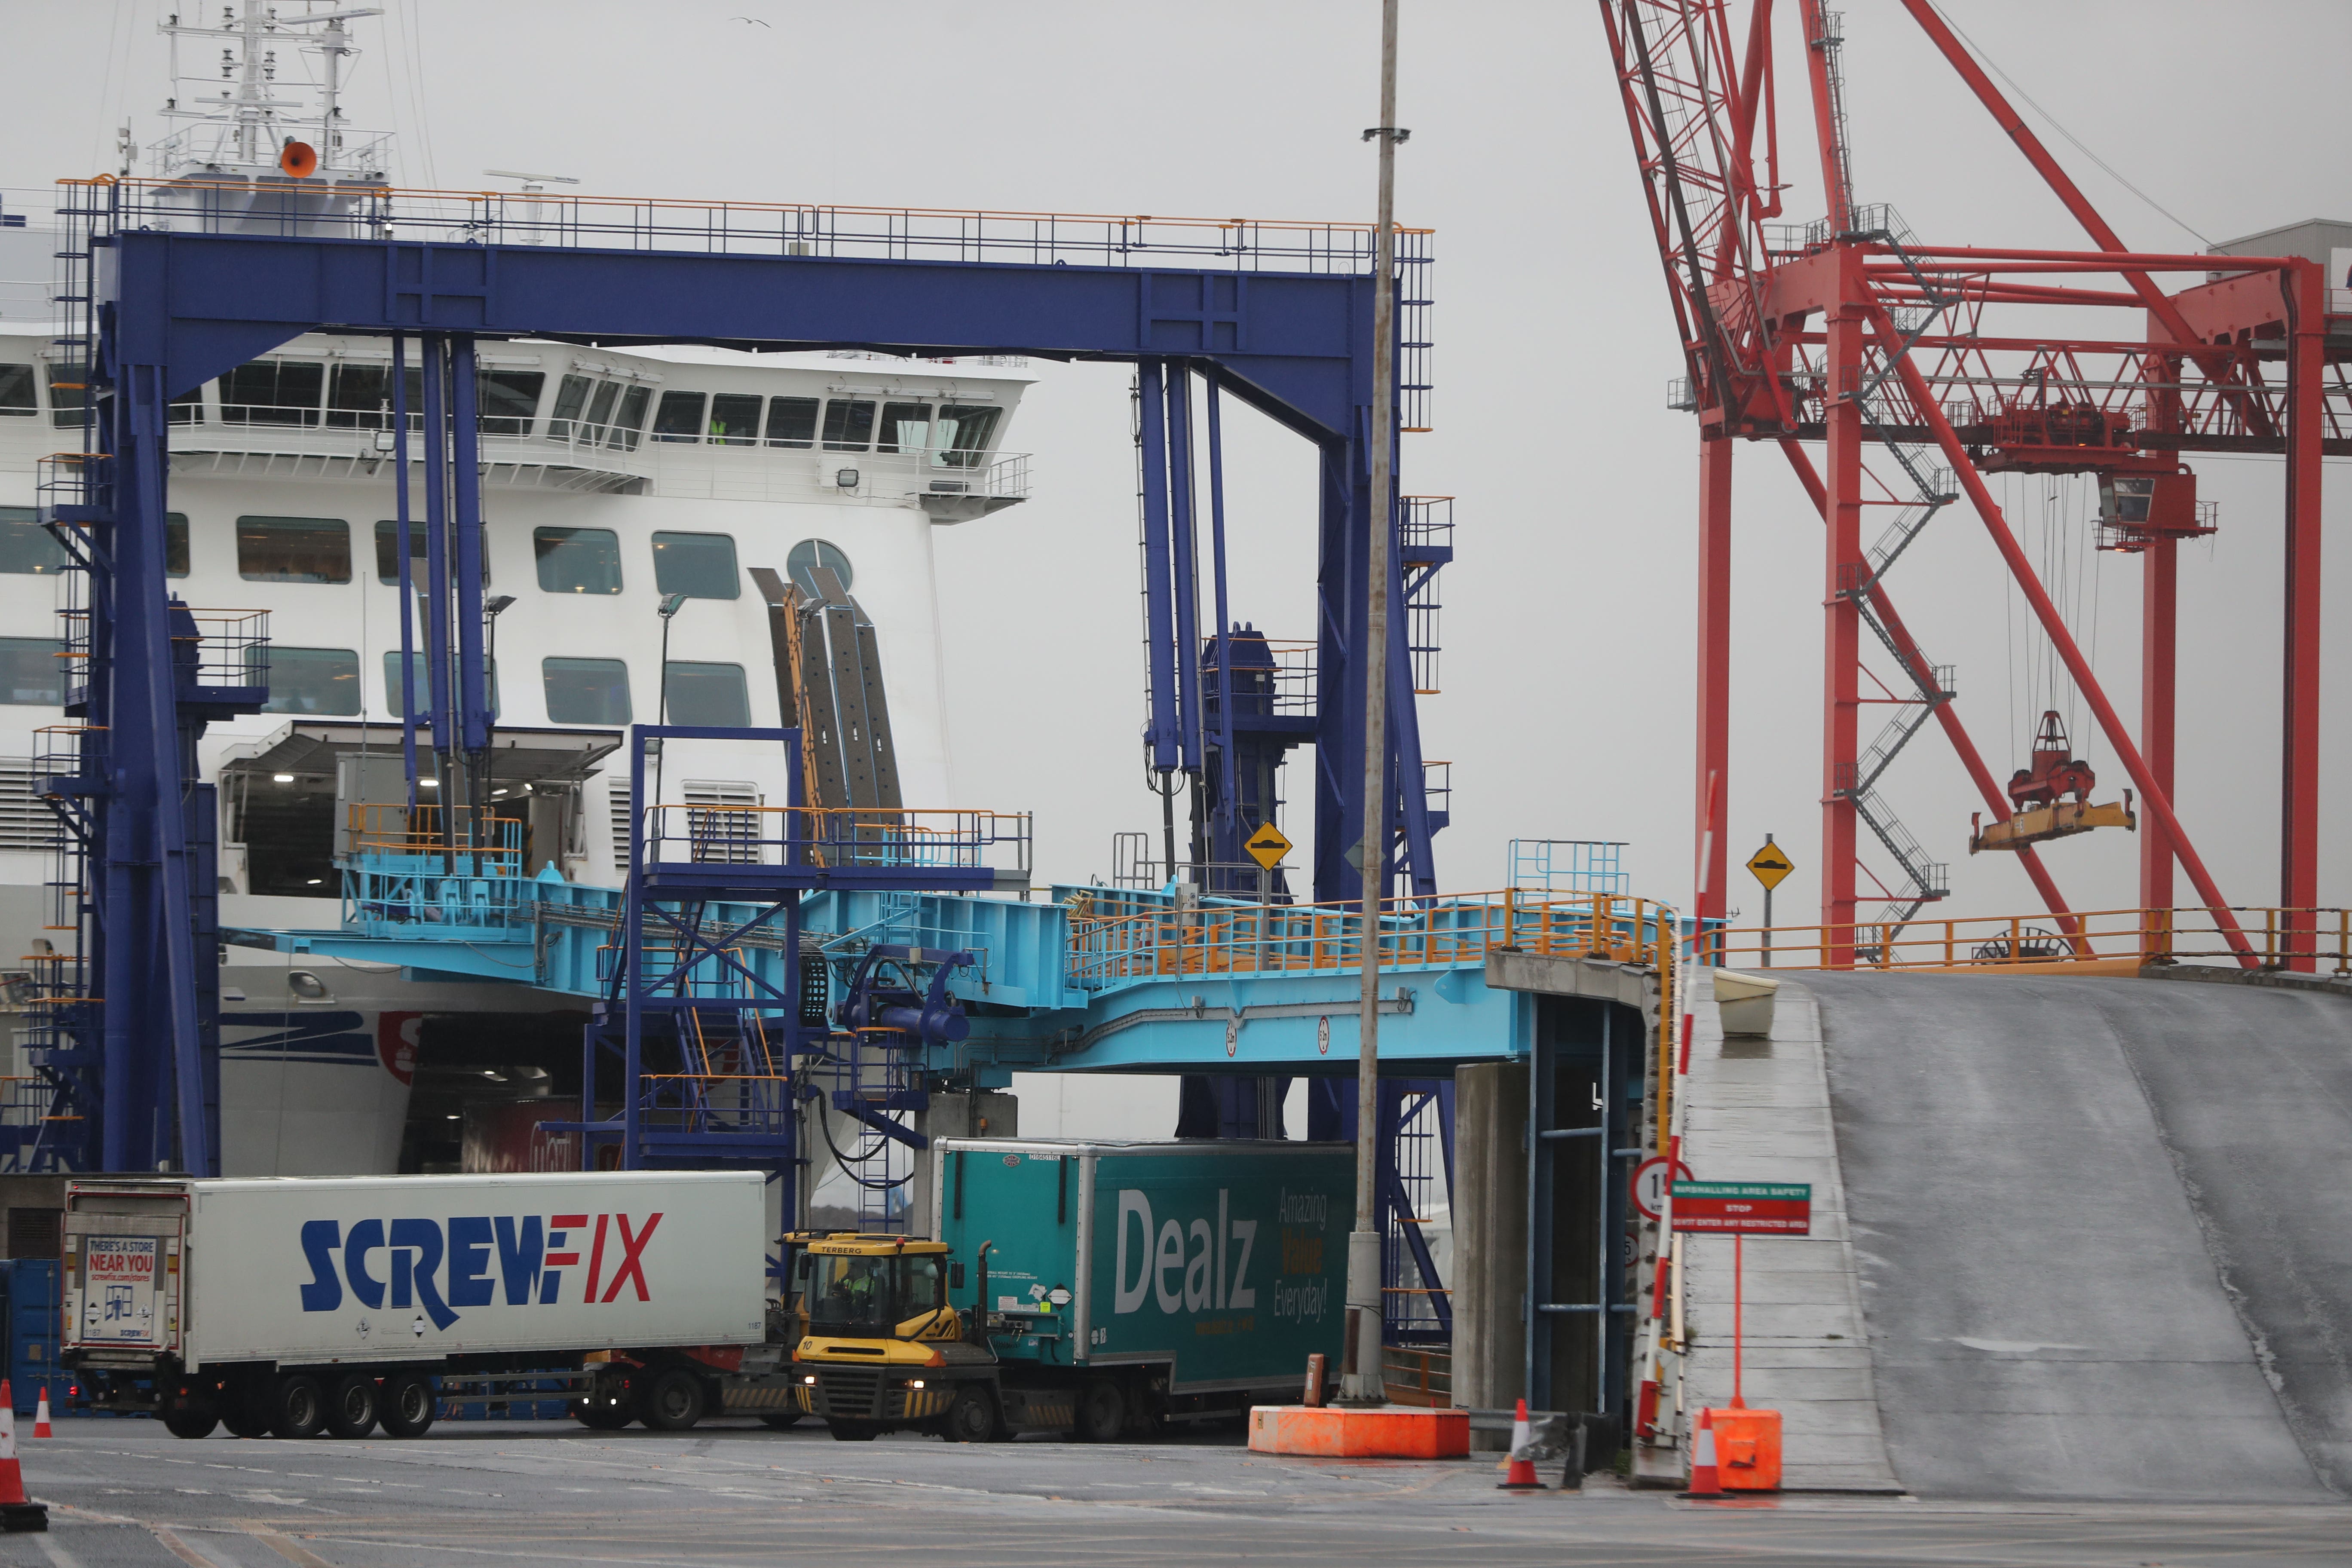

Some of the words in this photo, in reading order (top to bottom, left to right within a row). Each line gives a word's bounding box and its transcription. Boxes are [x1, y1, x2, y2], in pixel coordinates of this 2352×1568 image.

[1674, 1185, 1740, 1194] MARSHALLING
[1741, 1187, 1769, 1195] AREA
[1770, 1188, 1807, 1196] SAFETY
[1279, 1186, 1327, 1231] Amazing
[1725, 1204, 1752, 1213] STOP
[1740, 1219, 1787, 1228] RESTRICTED
[1789, 1220, 1807, 1228] AREA
[90, 1240, 119, 1252] THERE'S
[122, 1241, 128, 1252] A
[129, 1241, 153, 1253] STORE
[1115, 1188, 1258, 1314] Dealz
[1282, 1227, 1322, 1274] Value
[89, 1254, 124, 1271] NEAR
[127, 1255, 153, 1272] YOU
[91, 1273, 150, 1283] screwfix.com/stores
[300, 1213, 664, 1331] SCREWFIX
[1274, 1278, 1327, 1324] Everyday!
[748, 1322, 761, 1330] 1187
[803, 1341, 812, 1350] 10
